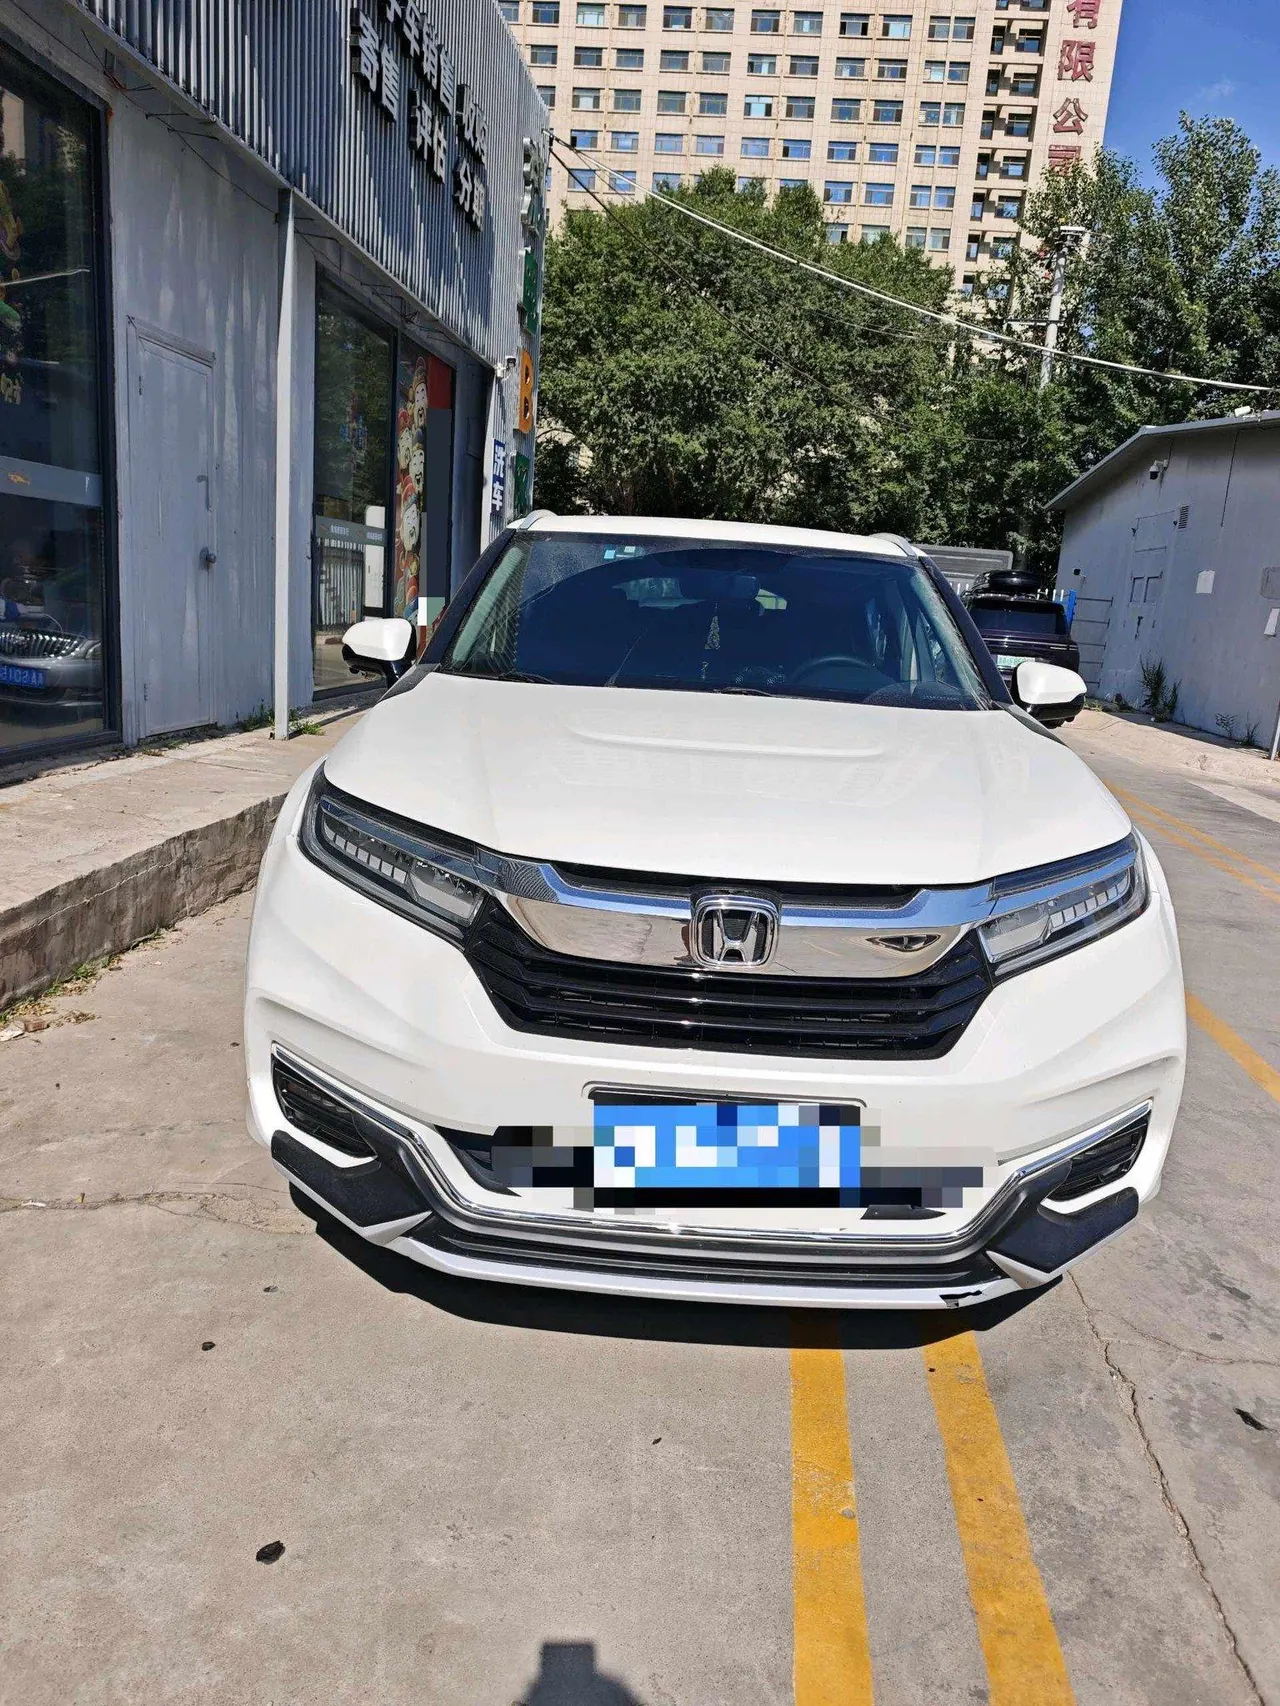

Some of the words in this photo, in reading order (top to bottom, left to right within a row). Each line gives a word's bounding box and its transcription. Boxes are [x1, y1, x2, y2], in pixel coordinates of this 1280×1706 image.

[359, 11, 400, 122] 寄售
[416, 90, 447, 184] 评估
[493, 445, 506, 511] 洗车
